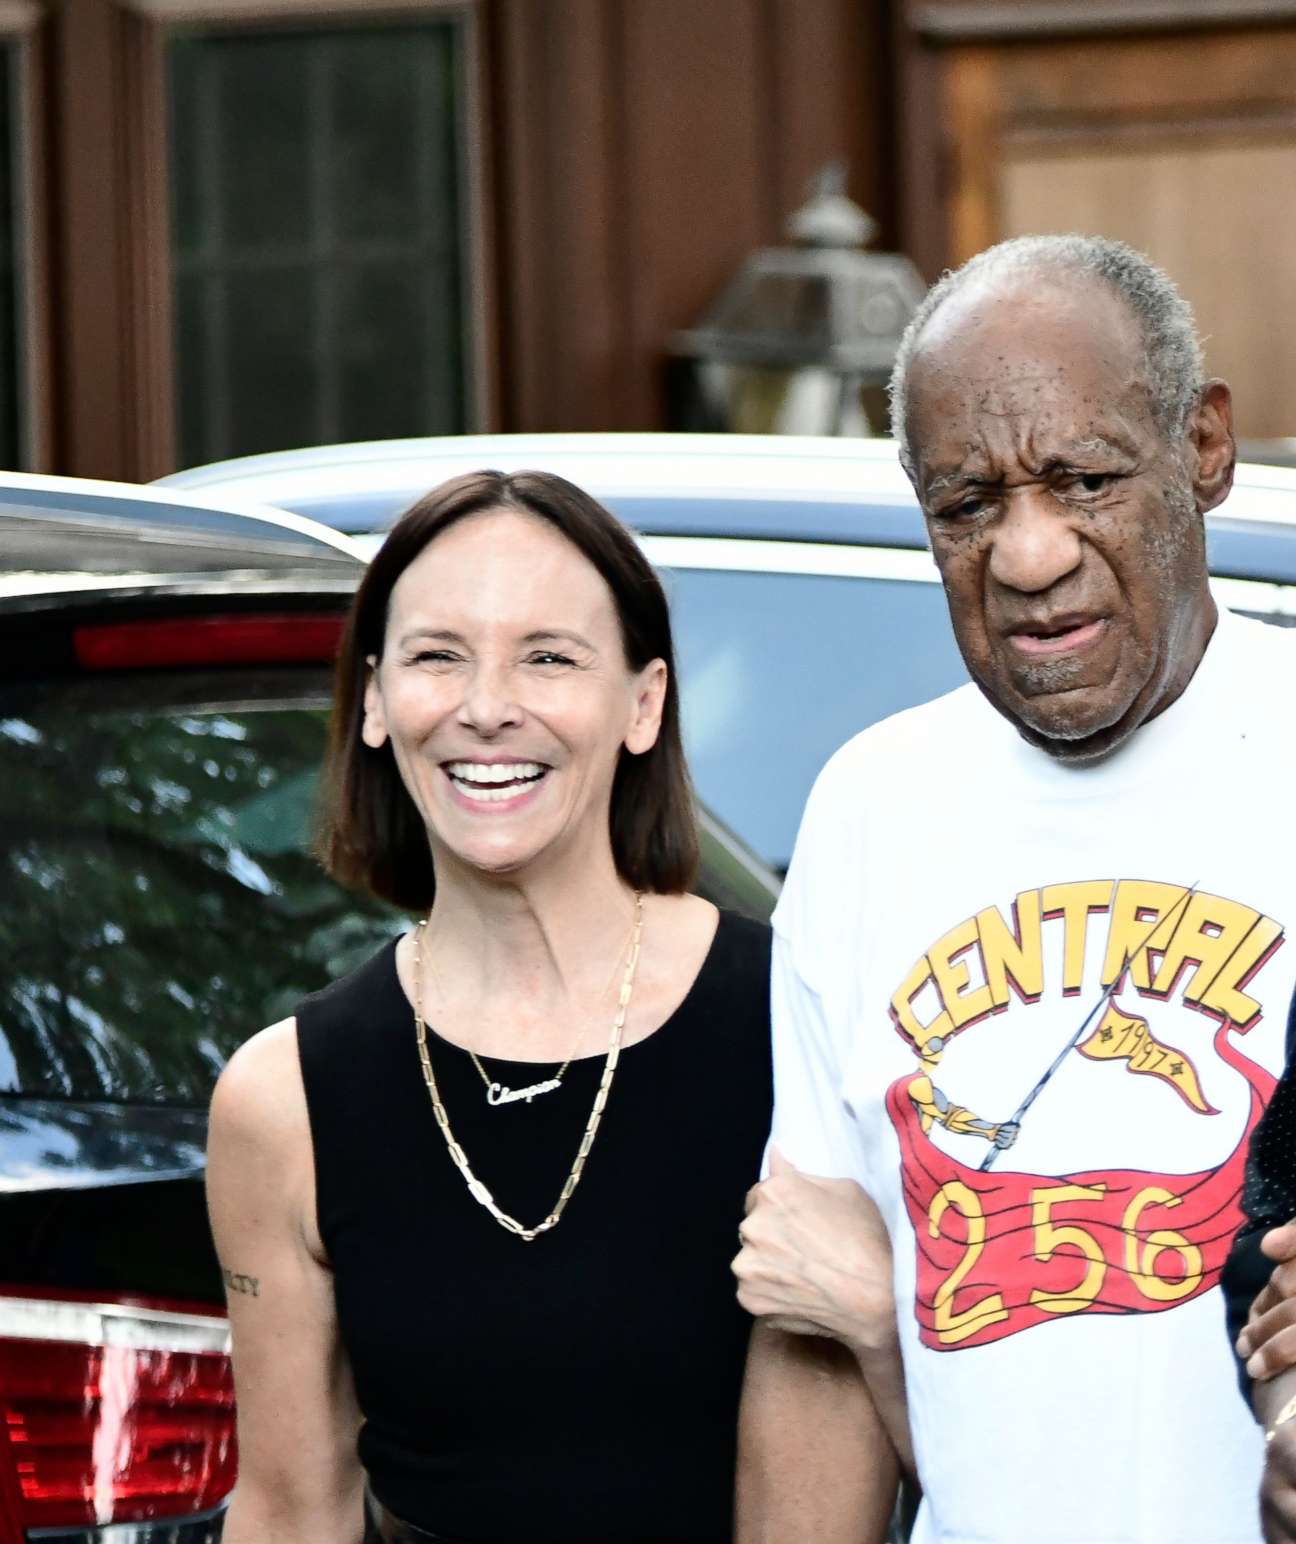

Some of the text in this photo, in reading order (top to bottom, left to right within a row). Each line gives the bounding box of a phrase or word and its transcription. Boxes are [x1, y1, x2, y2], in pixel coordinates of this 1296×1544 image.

[888, 878, 1286, 1050] CENTRAL
[1113, 1021, 1168, 1070] 1997
[222, 1267, 260, 1297] LTY
[928, 1180, 1203, 1344] 256
